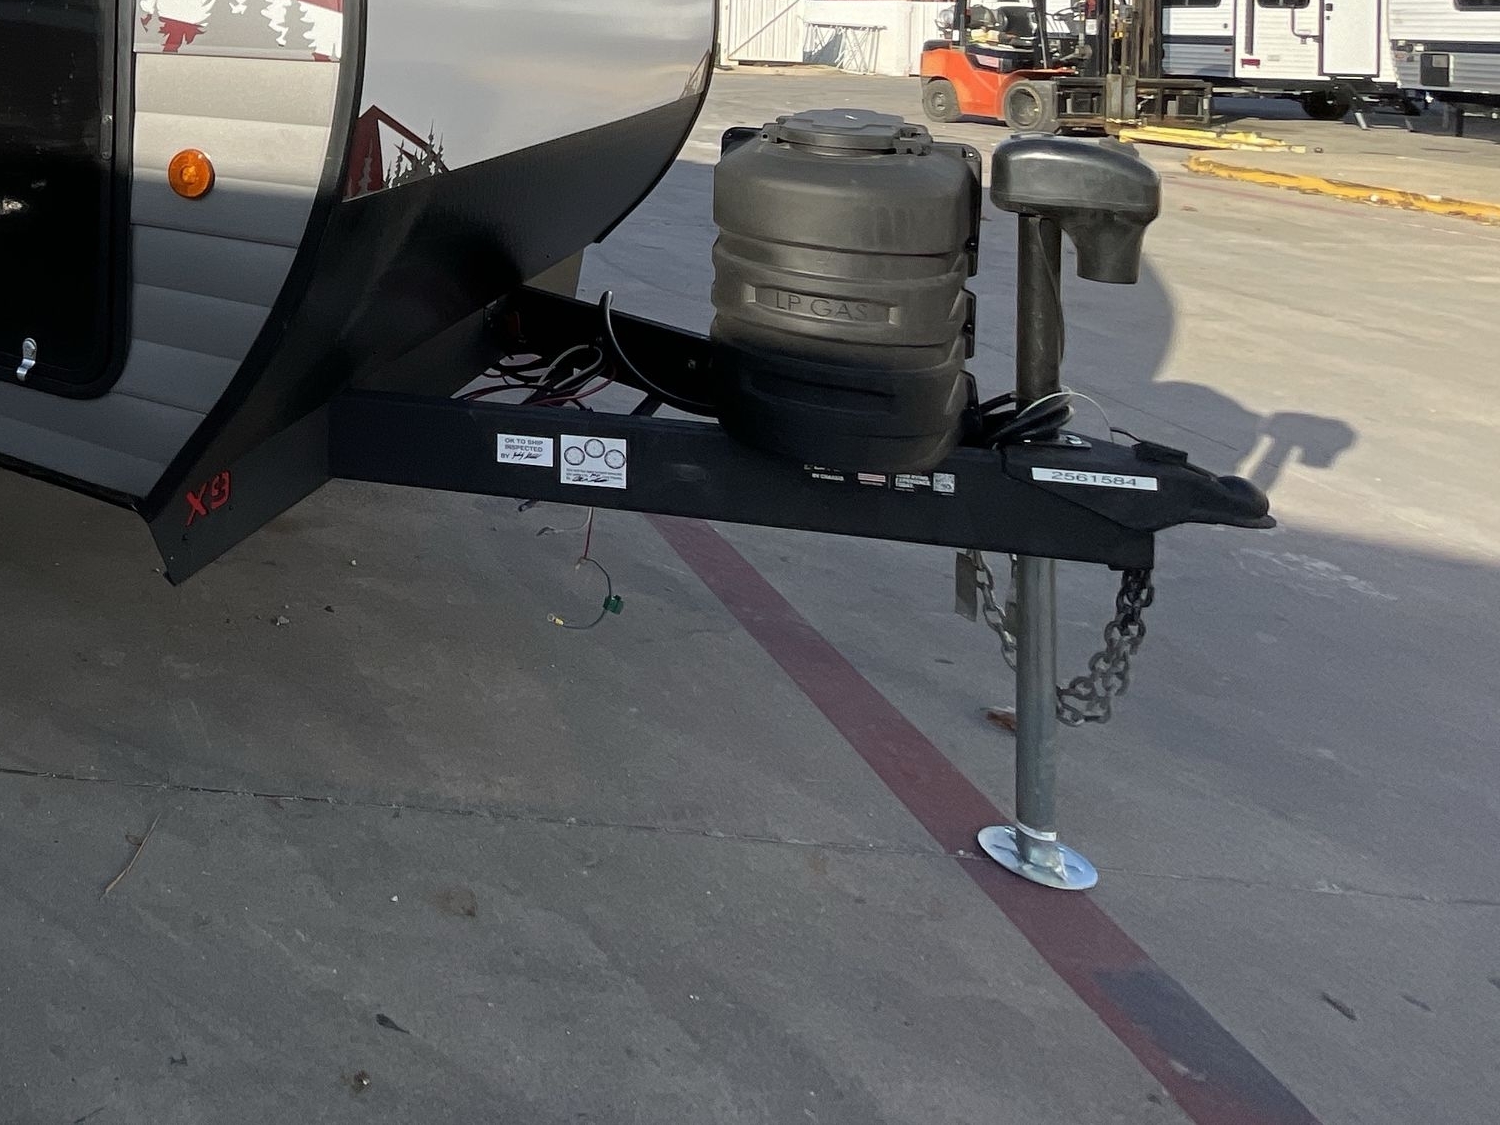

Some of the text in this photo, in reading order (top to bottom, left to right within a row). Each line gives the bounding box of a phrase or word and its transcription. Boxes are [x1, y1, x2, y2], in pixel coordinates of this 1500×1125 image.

[776, 291, 869, 321] LP GAS
[504, 444, 543, 453] INSPECTED
[1051, 471, 1138, 487] 2561584
